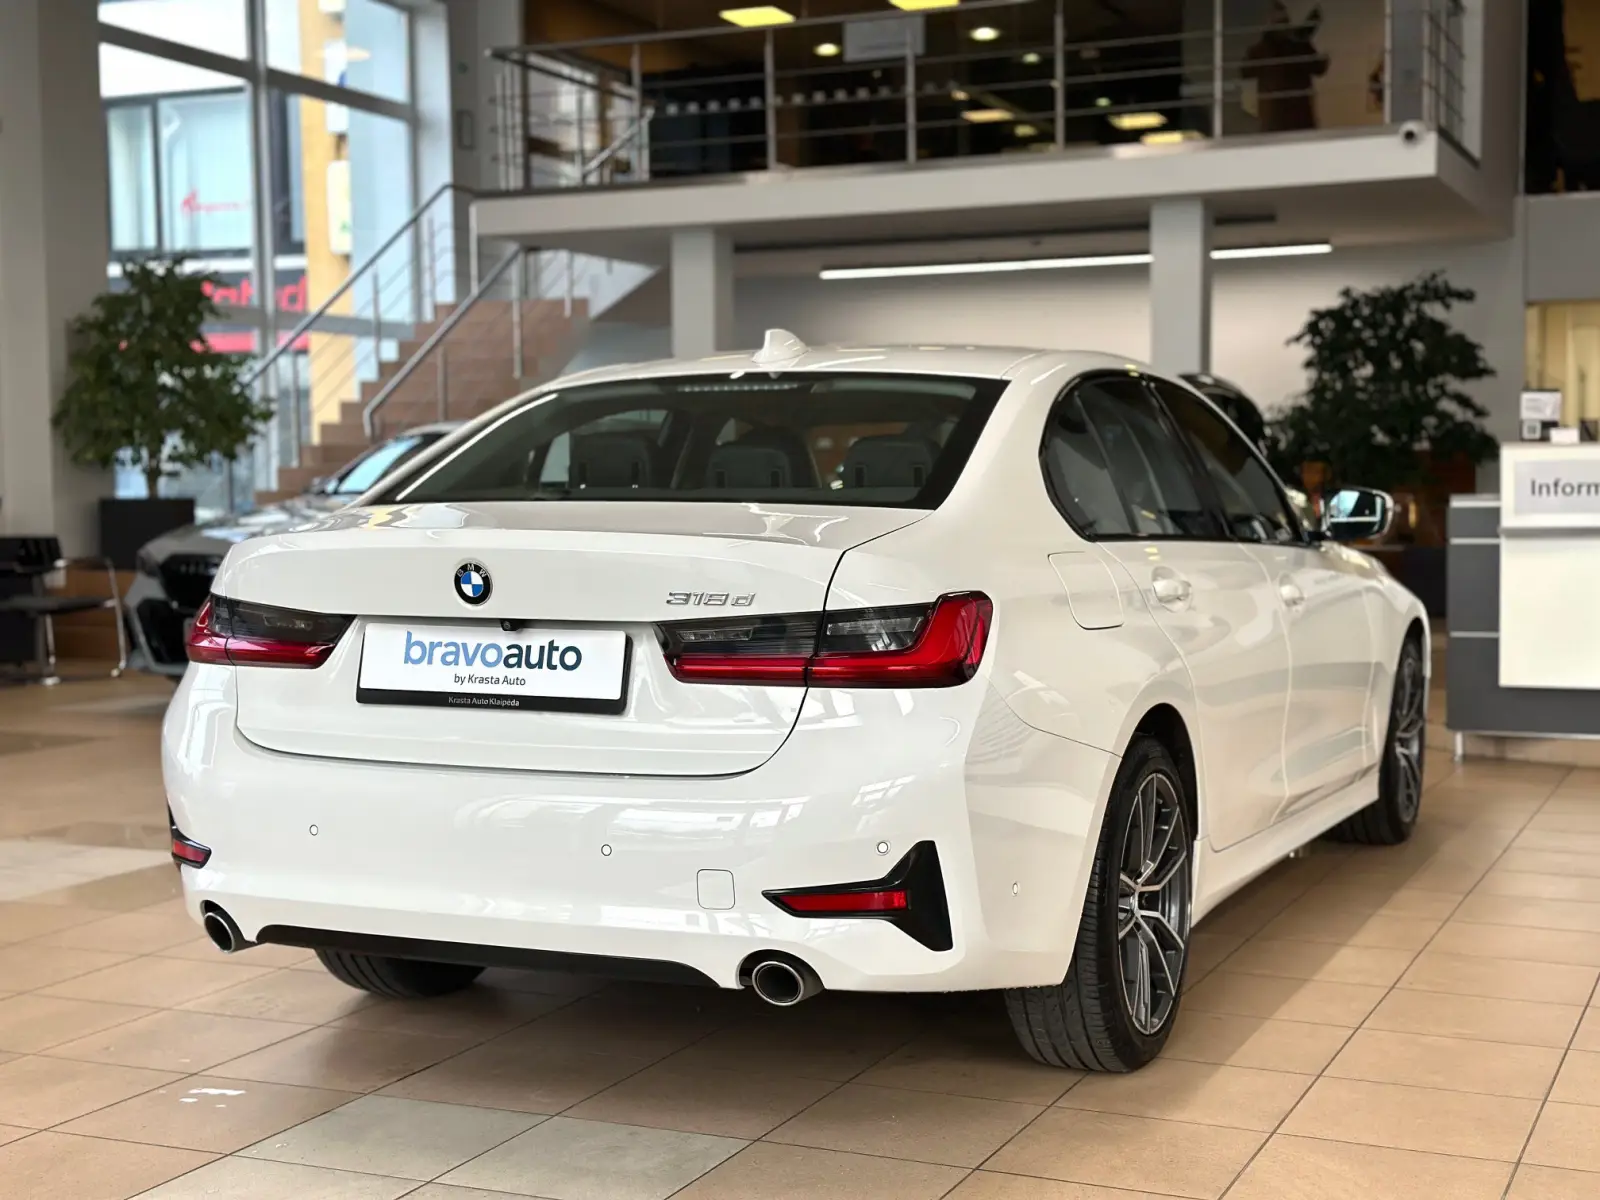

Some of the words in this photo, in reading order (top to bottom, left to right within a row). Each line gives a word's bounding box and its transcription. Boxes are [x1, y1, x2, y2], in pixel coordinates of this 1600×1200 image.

[456, 563, 488, 577] BMW
[666, 591, 756, 607] 318d
[403, 630, 583, 672] bravoauto
[453, 673, 466, 686] by
[467, 673, 500, 685] Krasta
[501, 675, 526, 686] Auto
[448, 696, 471, 704] Krasta
[471, 697, 489, 705] Auto
